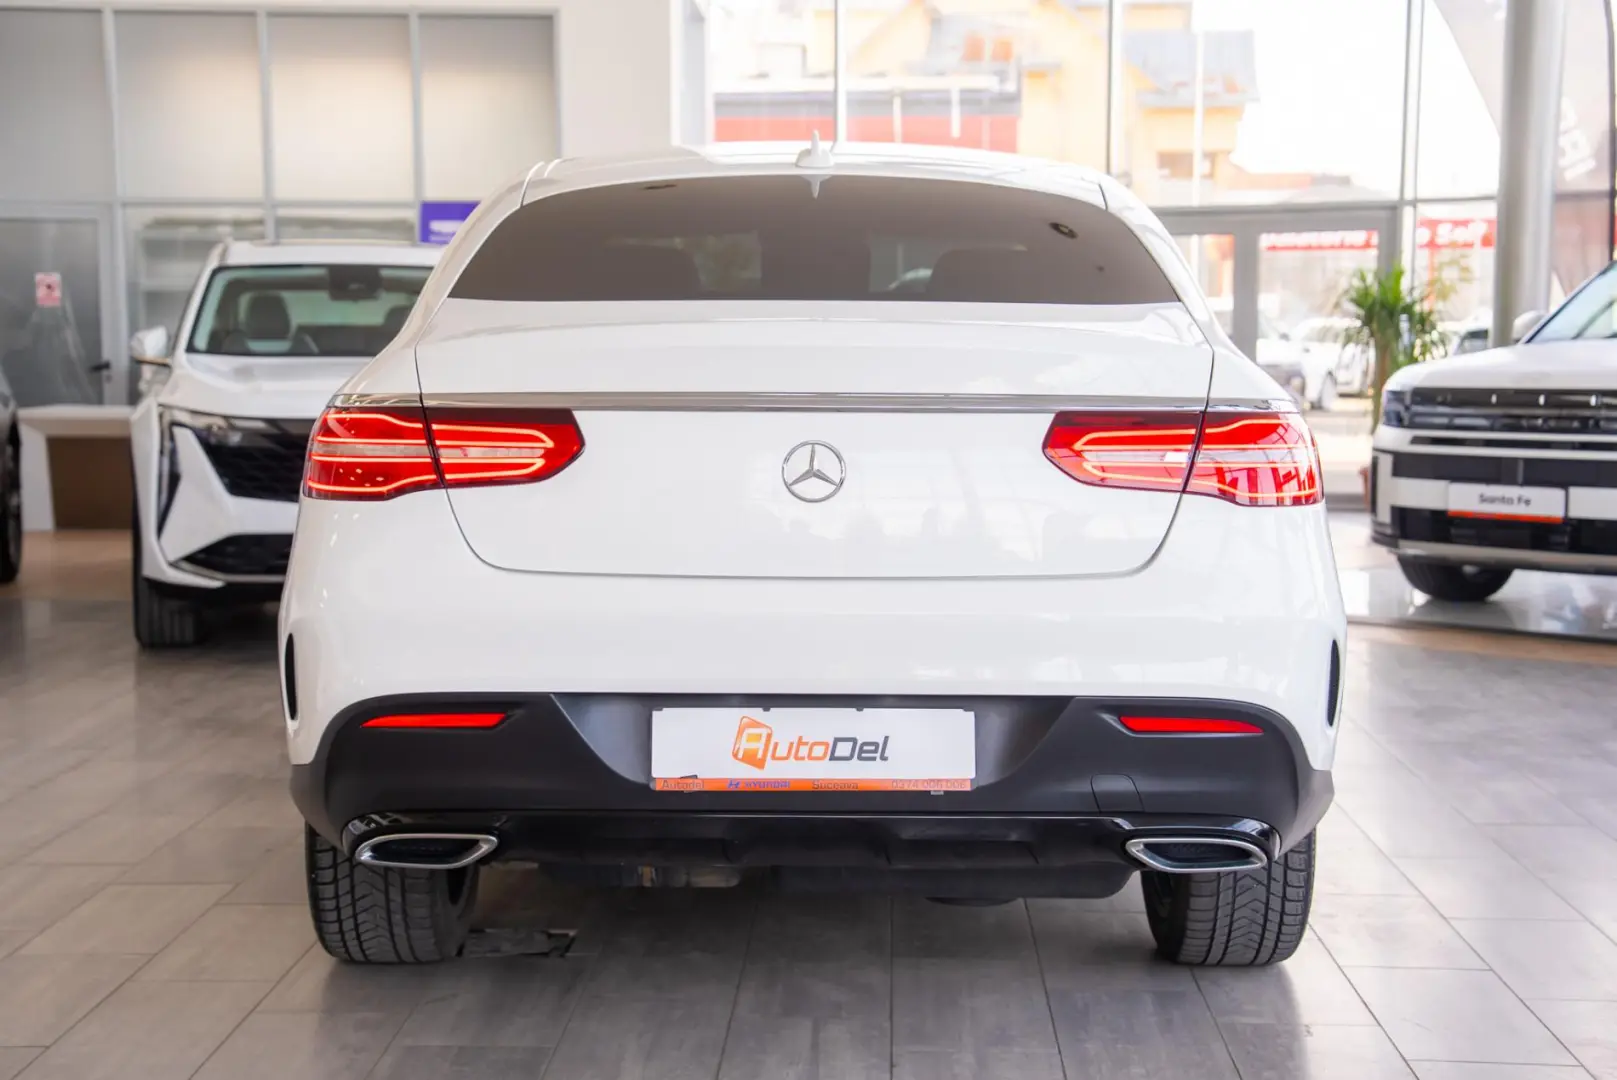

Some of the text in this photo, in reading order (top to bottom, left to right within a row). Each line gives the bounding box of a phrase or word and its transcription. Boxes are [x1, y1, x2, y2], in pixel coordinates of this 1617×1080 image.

[1479, 493, 1532, 507] Santa Fe
[736, 725, 890, 763] AutoDel
